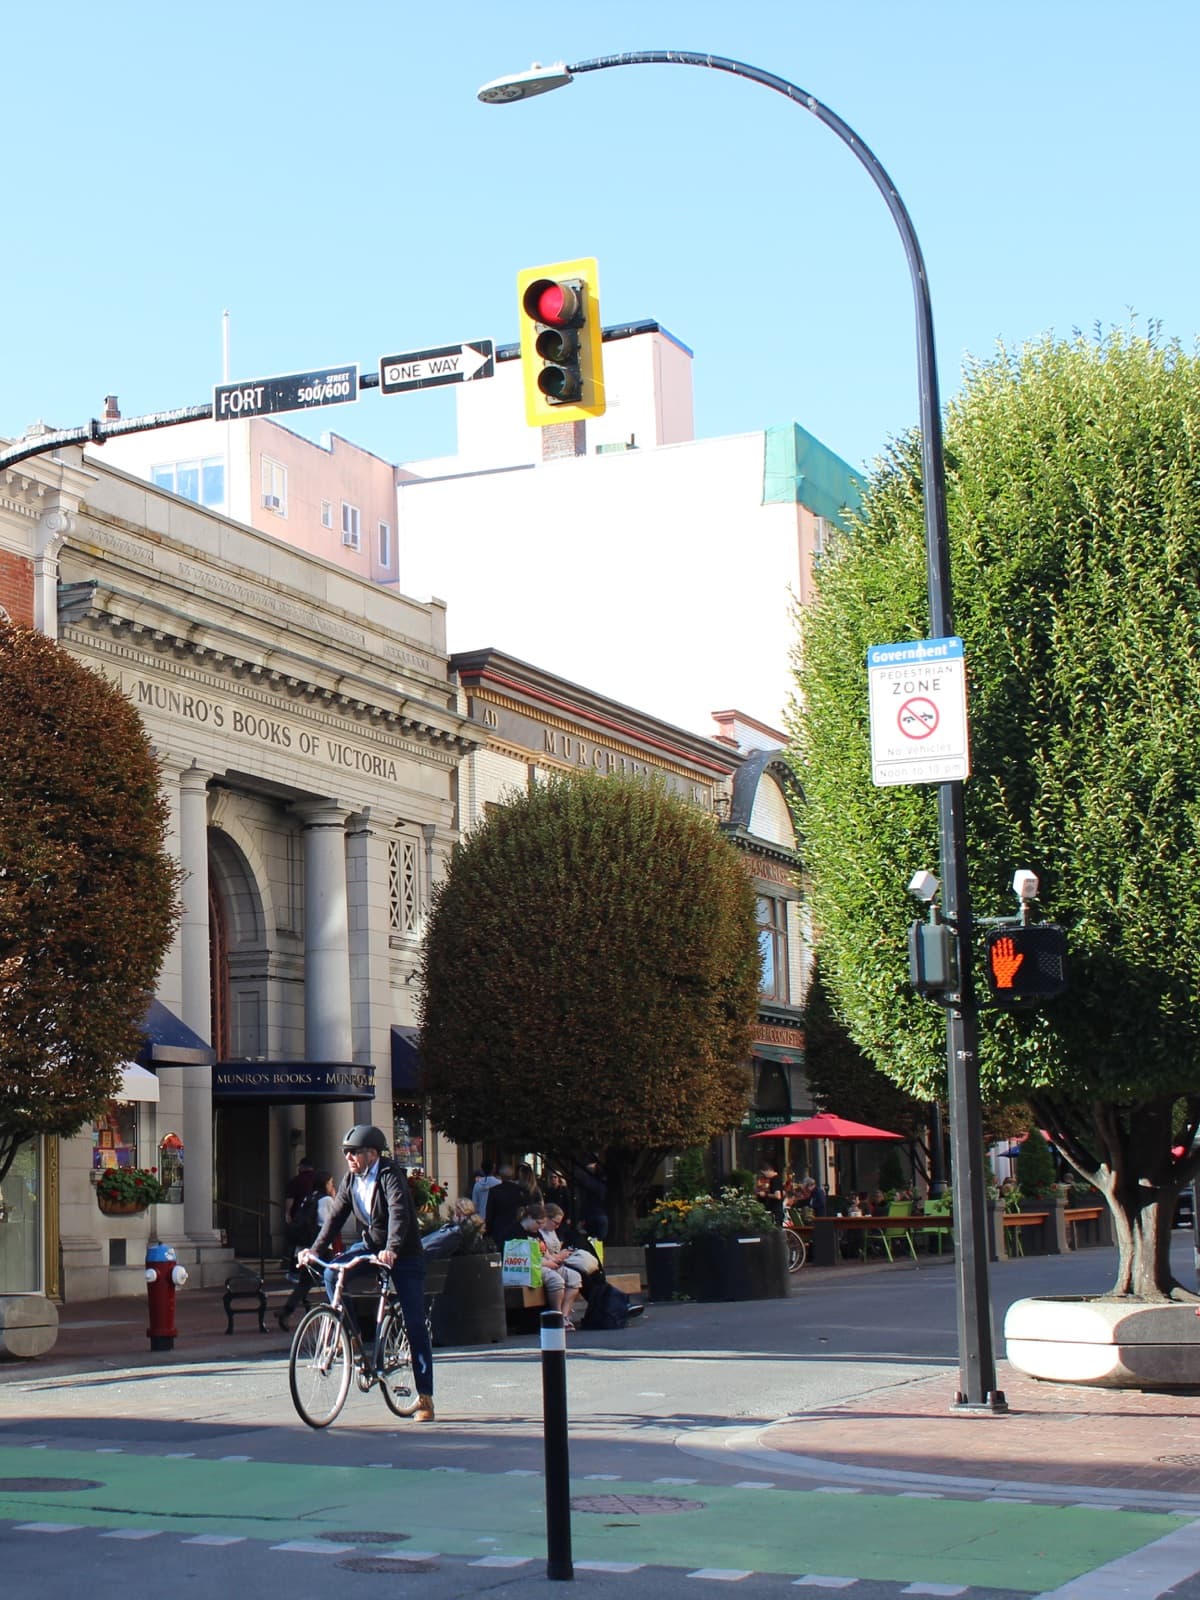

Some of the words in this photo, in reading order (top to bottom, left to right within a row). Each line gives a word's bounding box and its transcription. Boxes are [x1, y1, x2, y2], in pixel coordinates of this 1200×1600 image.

[326, 372, 350, 383] STREET
[389, 365, 421, 382] ONE
[429, 357, 460, 375] WAY
[220, 387, 264, 413] FORT
[297, 382, 350, 403] 500/600
[872, 644, 948, 663] Government
[880, 665, 953, 680] PEDESTRIAN
[892, 678, 941, 695] ZONE
[138, 680, 224, 727] MUNRO'S
[233, 710, 291, 748] BOOKS
[300, 732, 320, 756] OF
[327, 741, 398, 781] VICTORIA
[887, 747, 902, 757] No
[880, 767, 908, 779] Noon
[912, 765, 923, 776] to
[218, 1073, 269, 1086] MUNRO'S
[274, 1073, 312, 1084] BOOKS
